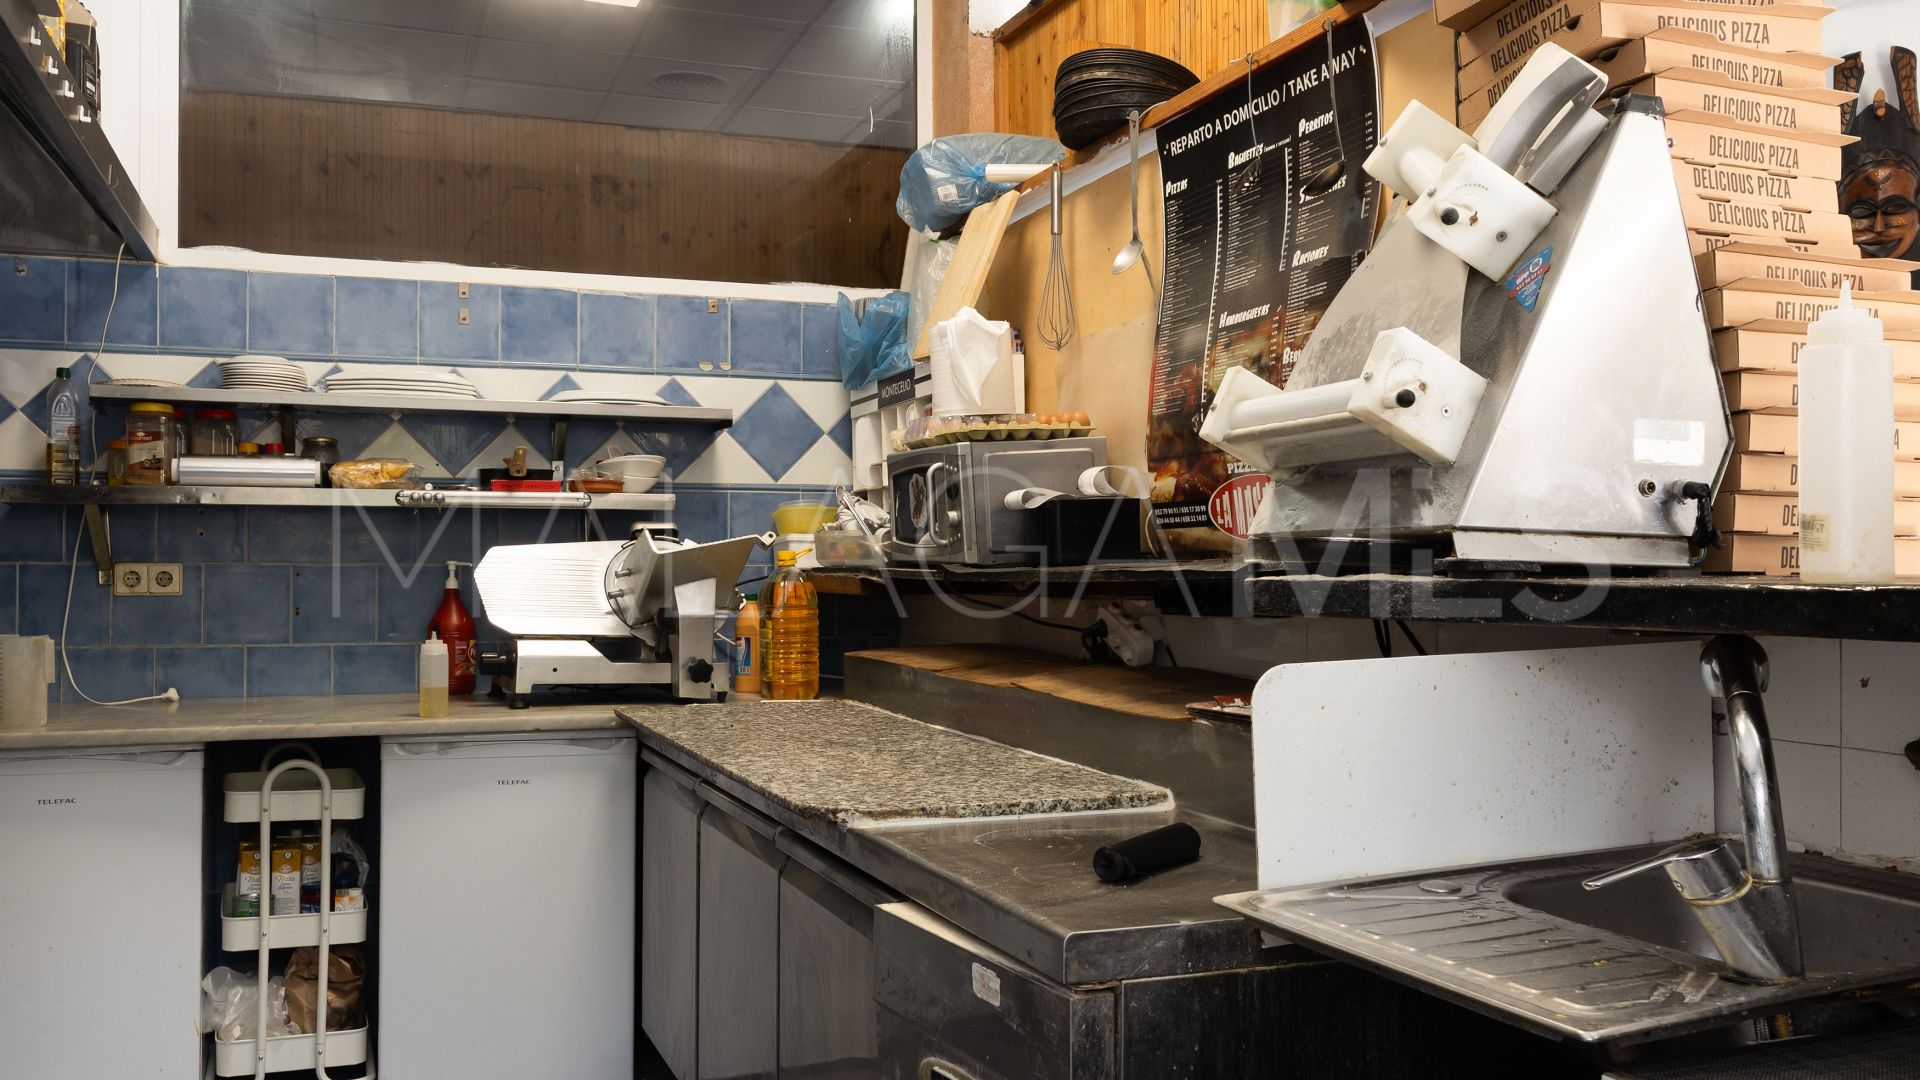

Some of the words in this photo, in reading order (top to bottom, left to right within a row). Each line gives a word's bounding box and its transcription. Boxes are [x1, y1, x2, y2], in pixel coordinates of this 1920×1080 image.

[1490, 25, 1540, 74] DELICIOUS
[1541, 4, 1571, 40] PIZZA
[1731, 21, 1770, 44] PIZZA
[1752, 65, 1784, 88] PIZZA
[1170, 123, 1213, 157] REPARTO
[1215, 118, 1223, 135] A
[1288, 67, 1319, 98] TAKE
[1321, 47, 1356, 82] AWAY
[1298, 111, 1334, 138] PERRITOS
[1765, 104, 1797, 129] PIZZA
[1228, 142, 1264, 170] BAGUETTES
[1709, 134, 1765, 165] DELICIOUS
[1768, 144, 1799, 169] PIZZA
[1165, 178, 1188, 198] PIZZAS
[1693, 167, 1754, 195] DELICIOUS
[1757, 176, 1792, 200] PIZZA
[1708, 202, 1769, 229] DELICIOUS
[1772, 210, 1806, 234] PIZZA
[1292, 245, 1330, 268] RACIONES
[1218, 303, 1271, 329] HAMBURGUESAS
